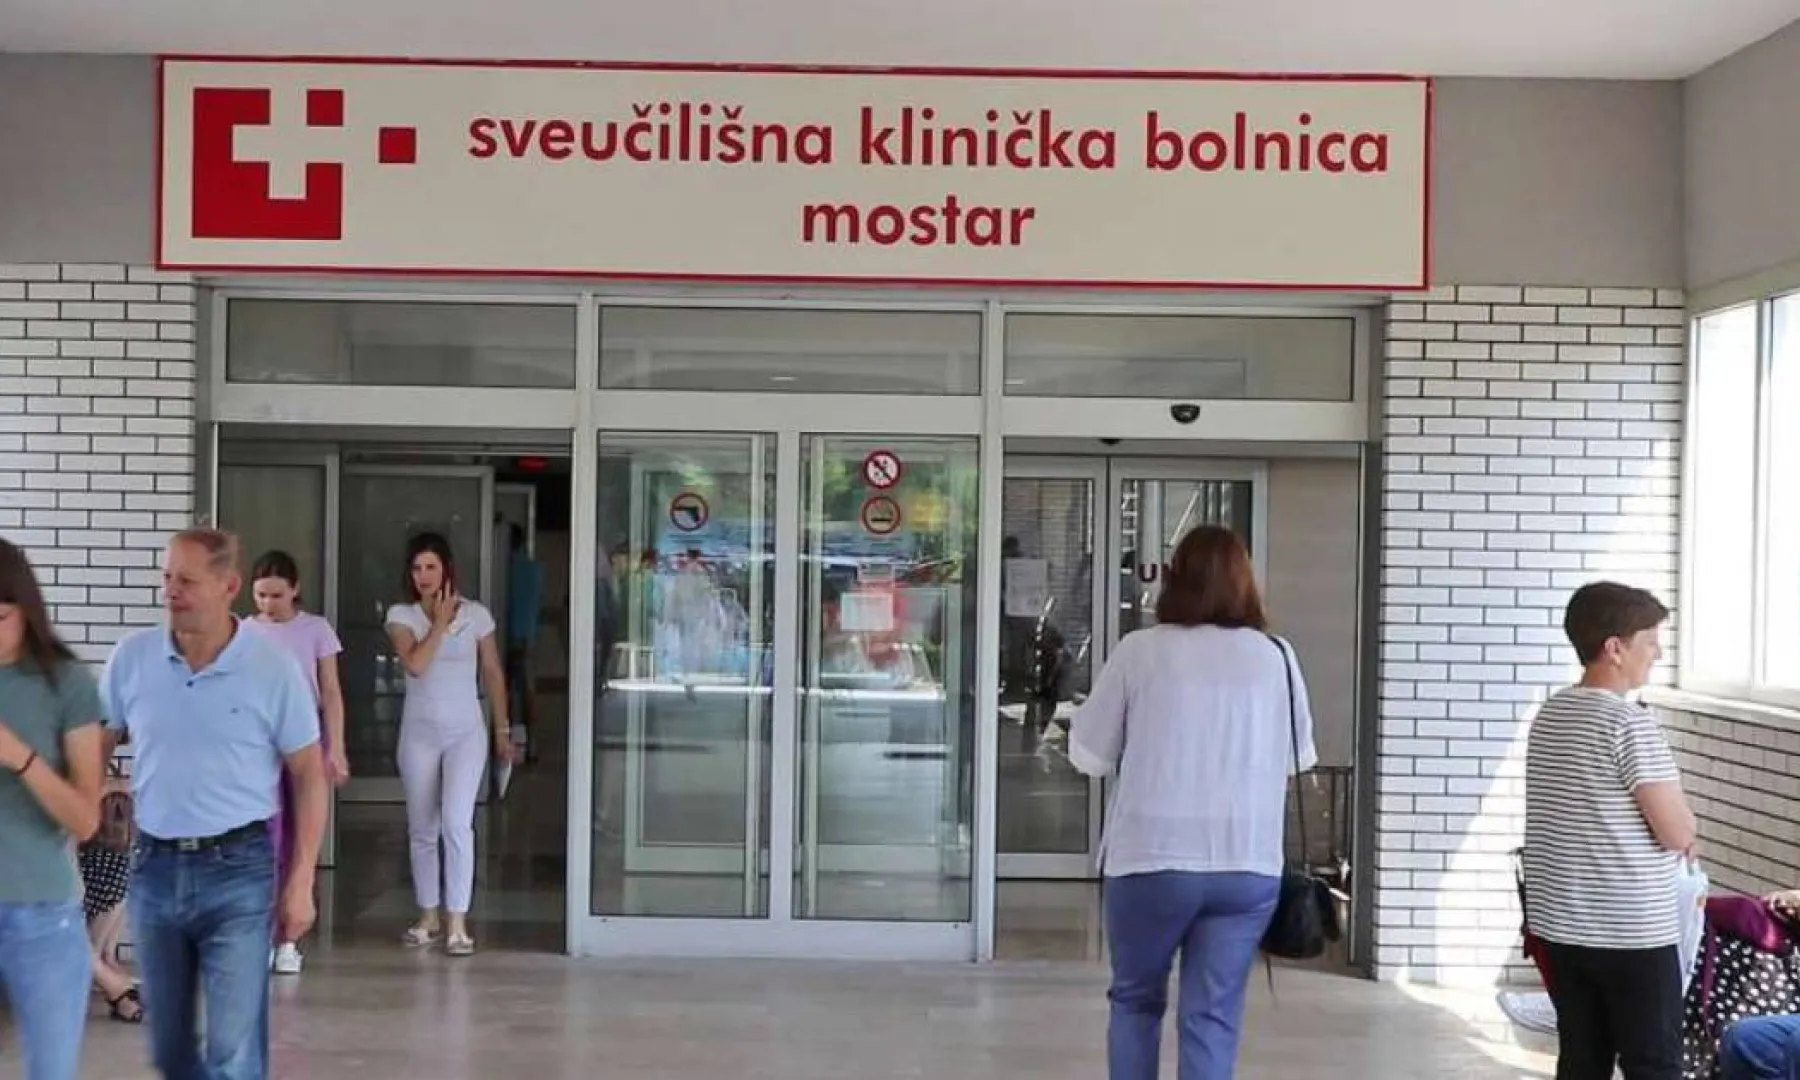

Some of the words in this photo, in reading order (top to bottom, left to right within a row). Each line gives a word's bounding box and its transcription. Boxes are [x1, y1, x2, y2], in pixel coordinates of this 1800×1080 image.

[470, 102, 834, 166] sveučilišna
[860, 108, 1119, 171] klinička
[1143, 111, 1390, 174] bolnica
[802, 192, 1036, 247] mostar
